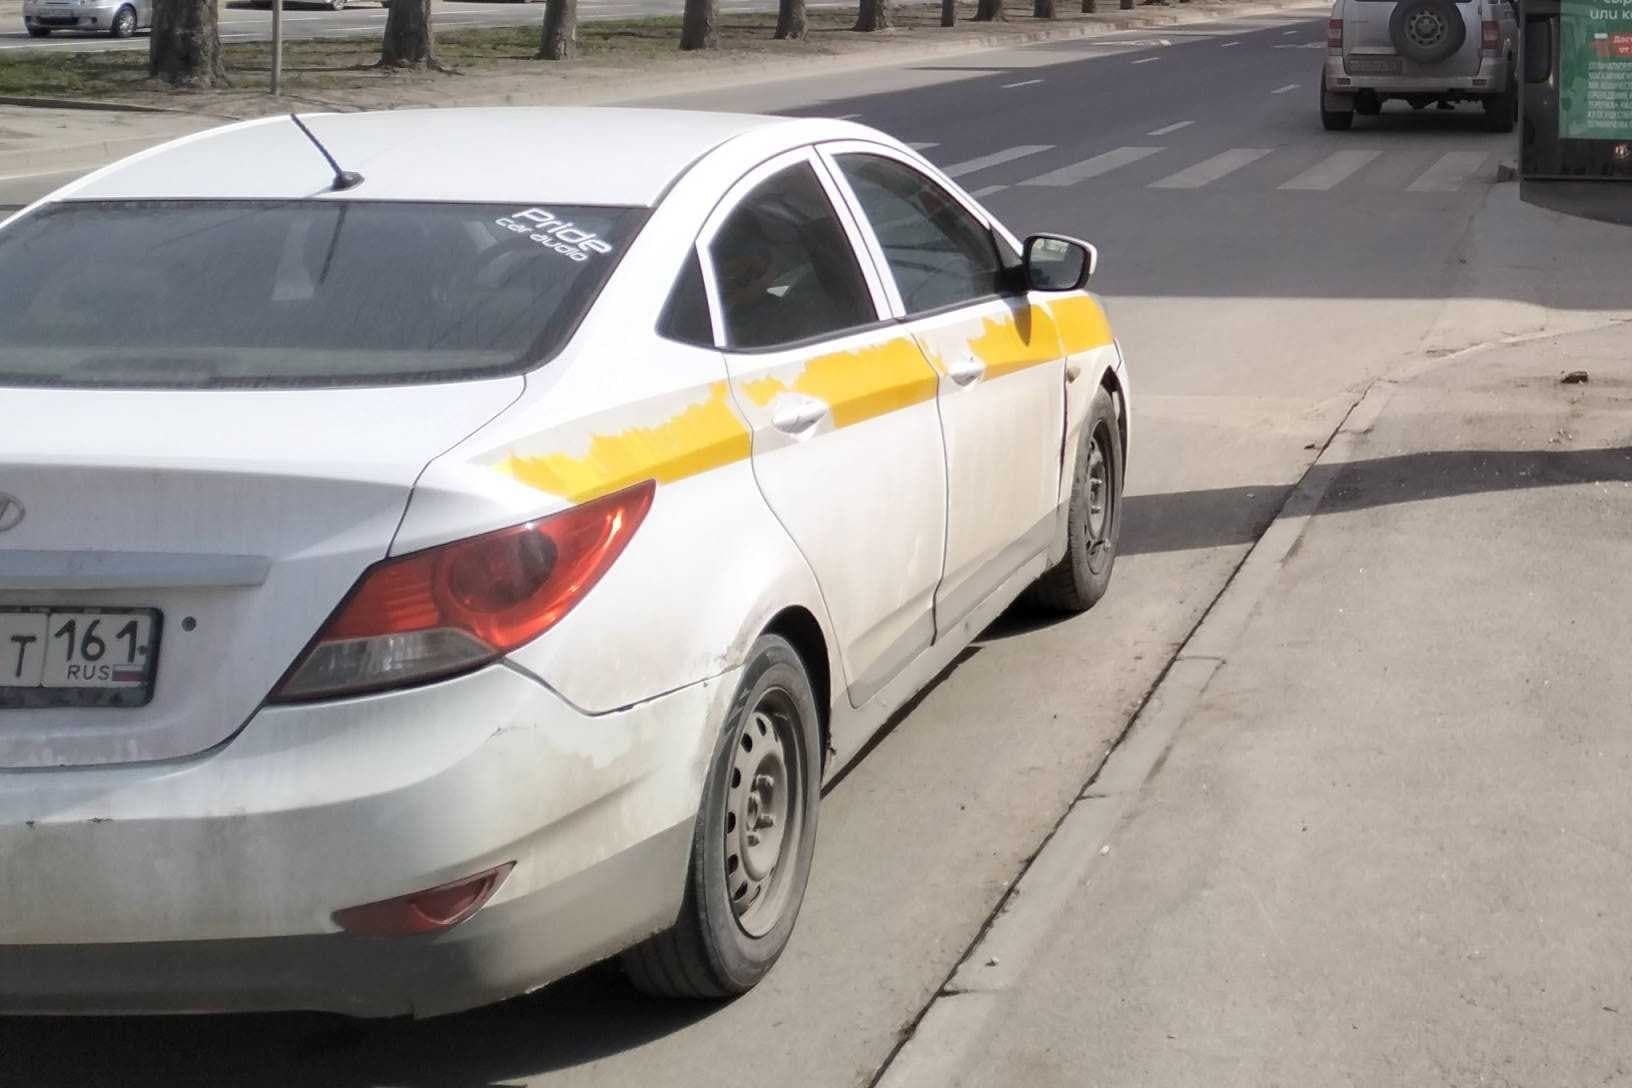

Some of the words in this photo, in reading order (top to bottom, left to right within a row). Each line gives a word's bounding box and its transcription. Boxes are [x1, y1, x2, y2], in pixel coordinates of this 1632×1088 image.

[1590, 9, 1618, 20] или
[495, 217, 534, 234] car
[529, 233, 590, 262] audio
[511, 207, 613, 255] Pride
[53, 618, 139, 663] 161
[66, 664, 110, 681] RUS
